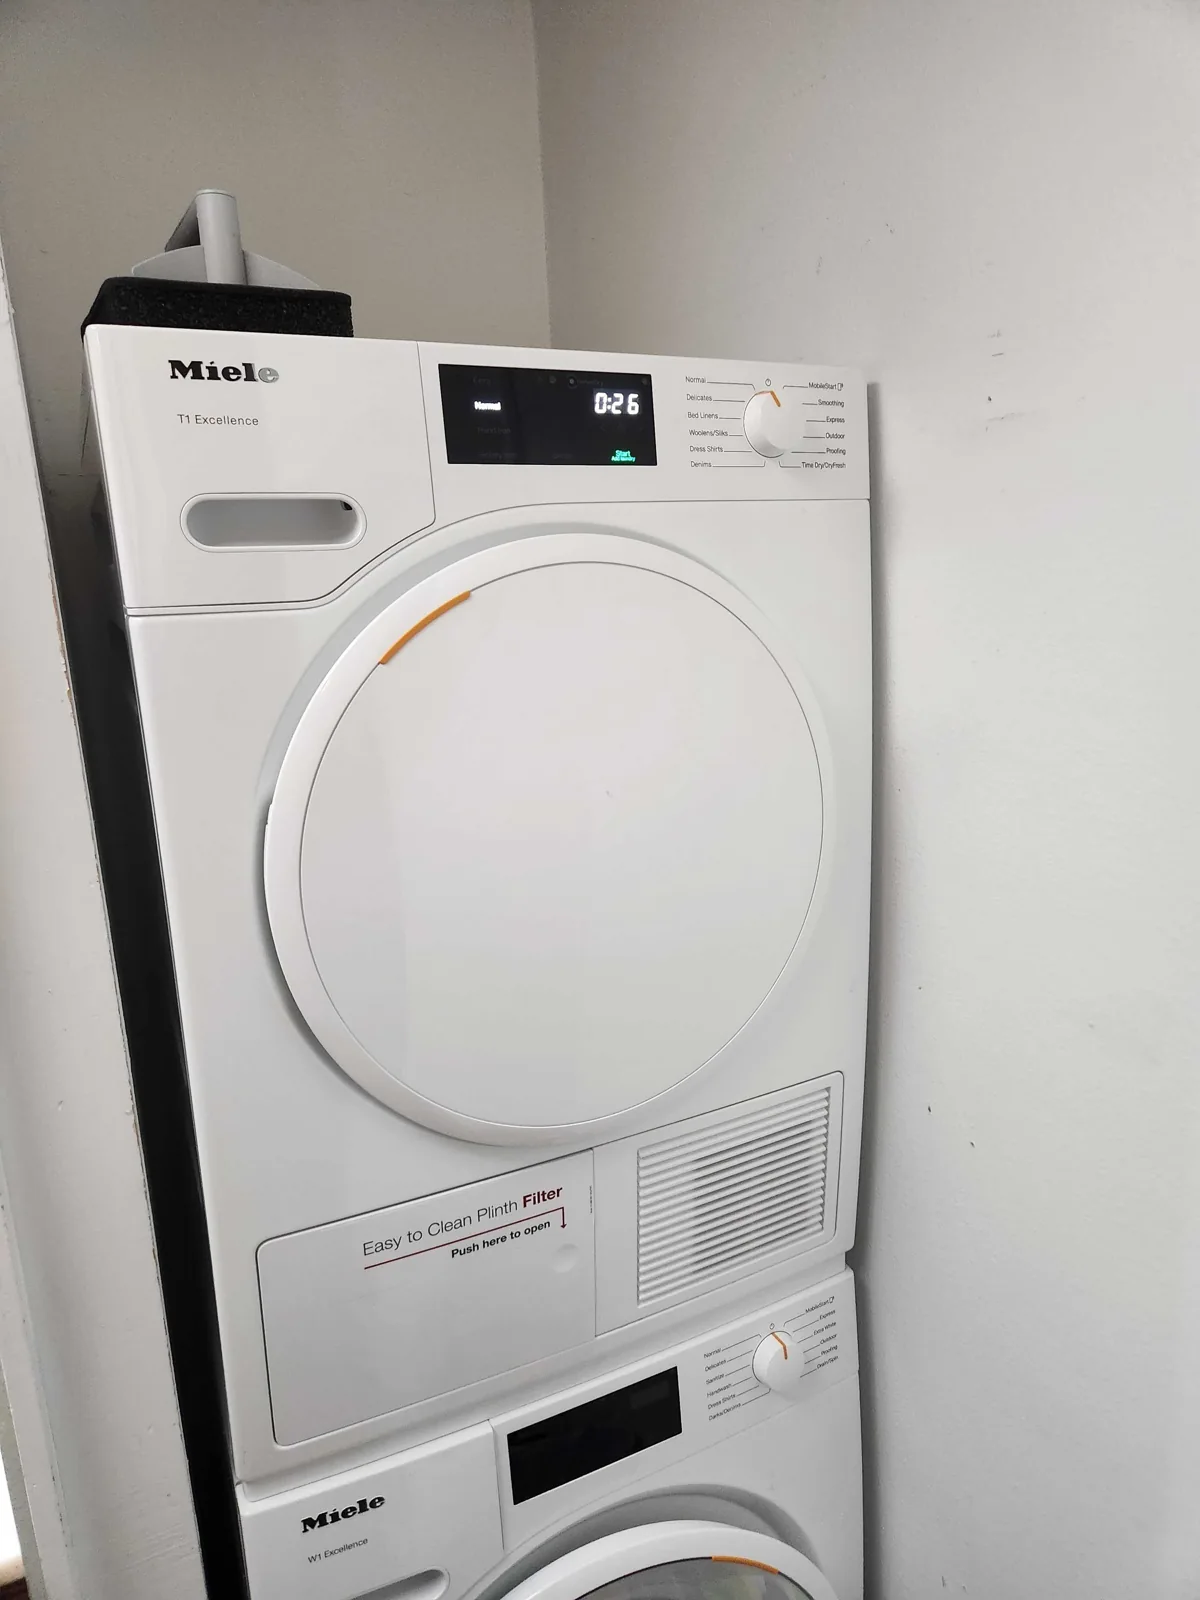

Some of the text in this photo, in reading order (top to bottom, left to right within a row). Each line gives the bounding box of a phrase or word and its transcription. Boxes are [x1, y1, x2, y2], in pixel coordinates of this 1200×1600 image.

[168, 360, 279, 383] Miele
[808, 382, 837, 390] MobileStart
[594, 392, 639, 415] 0:26
[686, 394, 713, 402] Delicates
[818, 399, 844, 408] Smoothing
[474, 401, 501, 411] Normal
[177, 413, 259, 426] T1 Excellence
[826, 416, 845, 424] Express
[826, 448, 846, 456] Proofing
[363, 1237, 402, 1257] Easy
[407, 1230, 423, 1243] to
[428, 1214, 472, 1237] Clean
[477, 1200, 518, 1222] Plinth
[522, 1186, 563, 1209] Filter
[451, 1220, 551, 1259] Push here to open
[819, 1310, 836, 1321] Express
[813, 1321, 837, 1336] Extra White
[819, 1333, 838, 1345] Outdoor
[703, 1347, 722, 1359] Normal
[820, 1344, 838, 1356] Proofing
[704, 1359, 727, 1372] Delicates
[705, 1373, 725, 1385] Sanitize
[706, 1383, 732, 1398] Handwash
[707, 1393, 736, 1410] Dress Shirts
[301, 1495, 386, 1533] Miele
[307, 1538, 369, 1563] W1 Excellence
